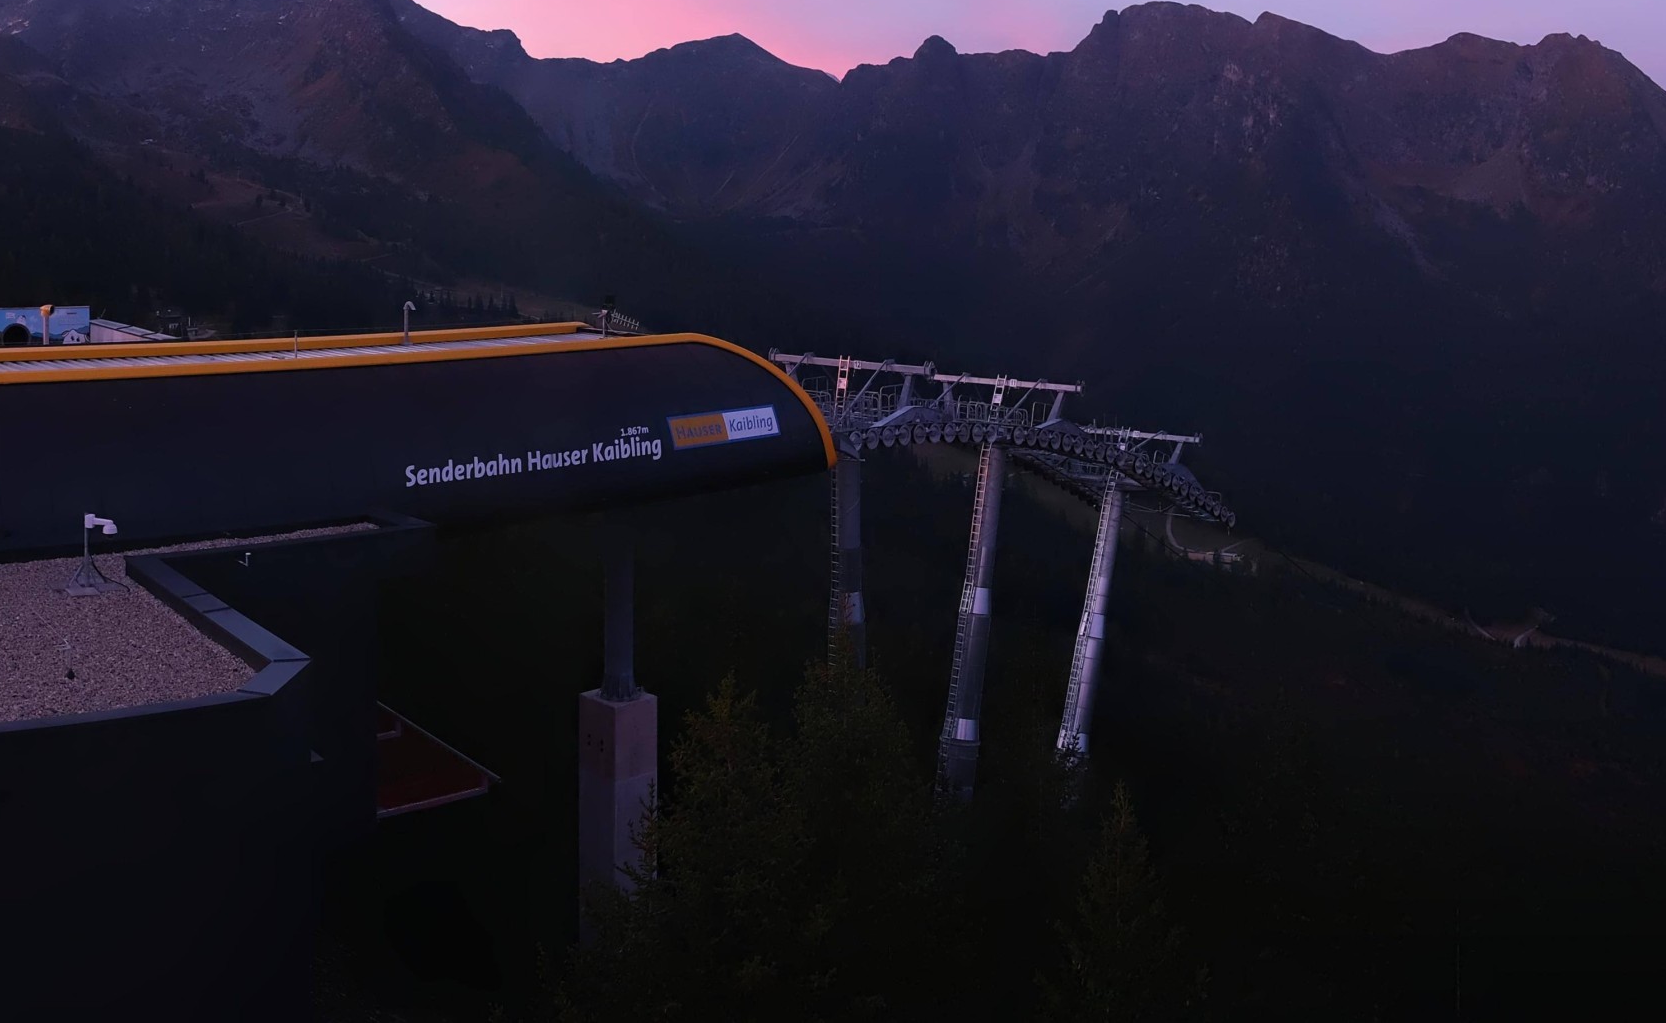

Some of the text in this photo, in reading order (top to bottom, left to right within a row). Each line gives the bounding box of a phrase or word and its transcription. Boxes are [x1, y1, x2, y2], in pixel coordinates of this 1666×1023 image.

[620, 425, 650, 437] 1.867m
[675, 415, 774, 440] HAUSER Kaibling
[405, 435, 662, 487] Senderbahn Hauser Kaibling
